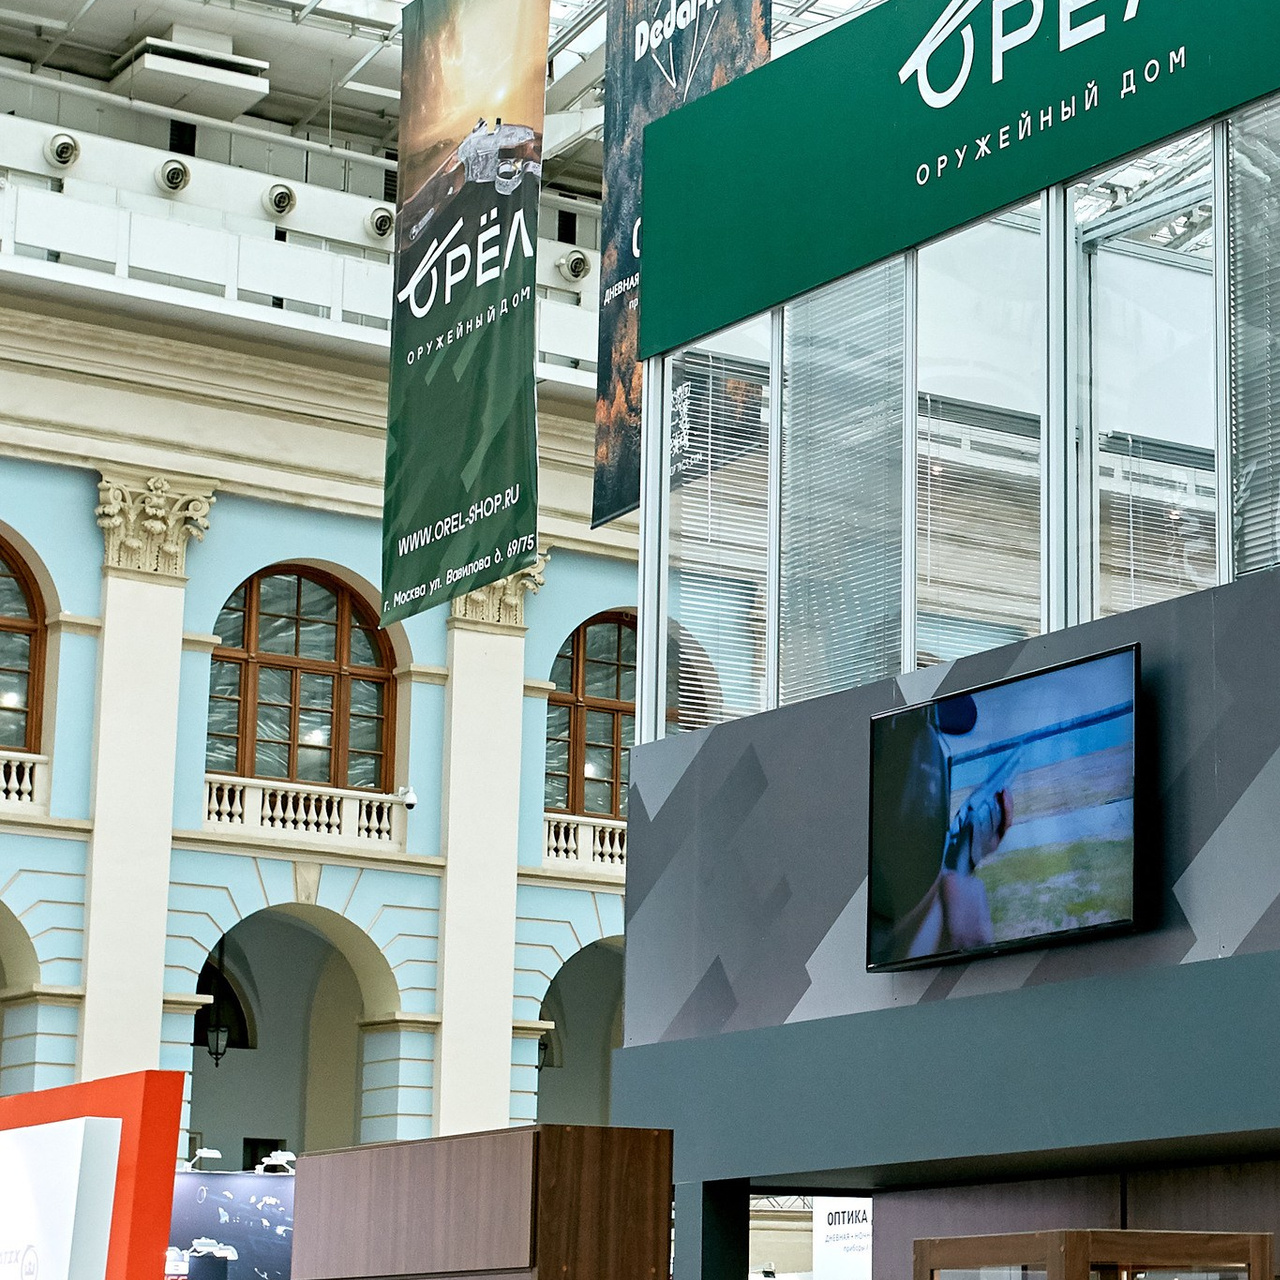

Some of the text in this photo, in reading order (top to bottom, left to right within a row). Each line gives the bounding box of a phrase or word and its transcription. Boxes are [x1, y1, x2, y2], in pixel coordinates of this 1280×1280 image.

[915, 46, 1186, 186] ОРУЖЕЙНЫЙ ДОМ
[397, 207, 533, 318] ОРЁЛ
[604, 272, 640, 306] ДНЕВНАЯ
[407, 286, 531, 365] ОРУЖЕЙНЫЙ ДОМ
[398, 484, 520, 556] WWW.OREL-SHOP.RU
[383, 534, 535, 612] г. Москва ул. Вавилова д. 69/75
[827, 1209, 868, 1226] ОПТИКА
